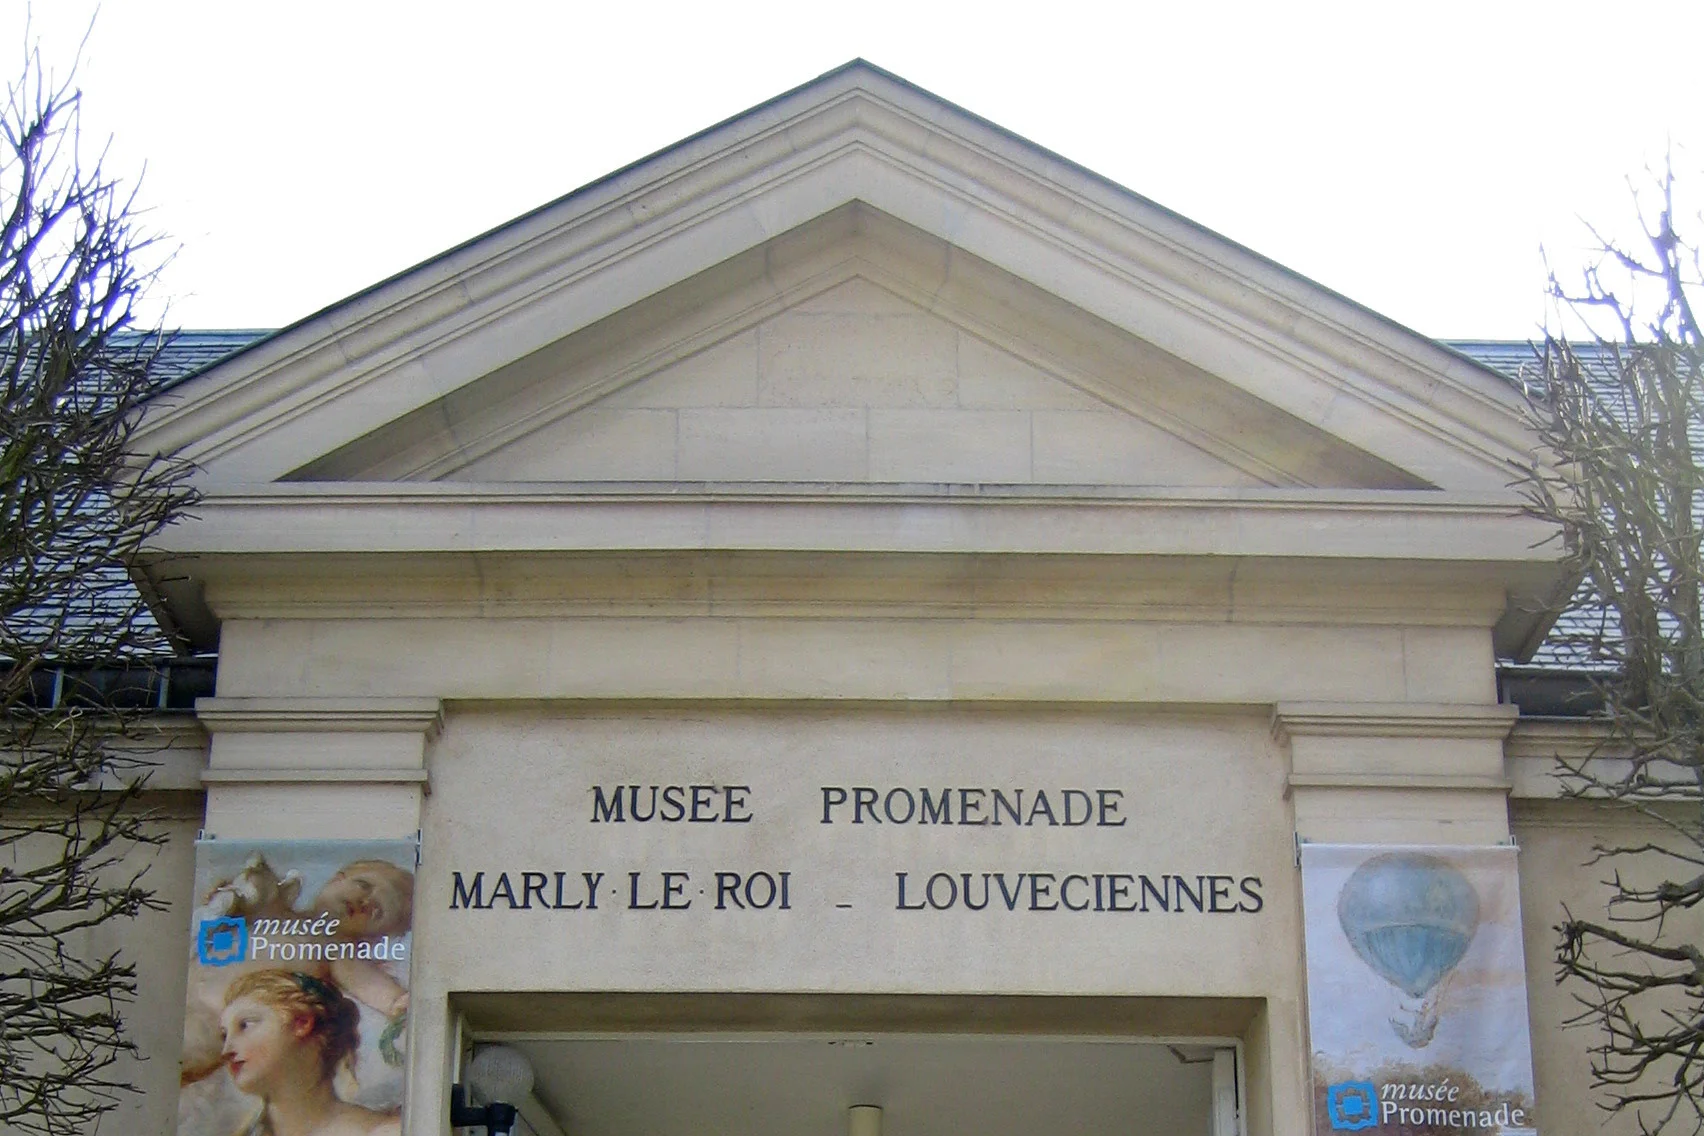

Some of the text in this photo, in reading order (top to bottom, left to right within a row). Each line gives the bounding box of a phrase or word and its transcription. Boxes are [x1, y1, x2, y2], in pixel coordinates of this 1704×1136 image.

[590, 786, 1127, 827] MUSEE PROMENADE
[895, 872, 1264, 913] LOUVECIENNES
[253, 911, 341, 936] musée
[250, 936, 406, 961] Promenade
[1381, 1078, 1459, 1101] musée
[1381, 1101, 1525, 1128] Promenade
